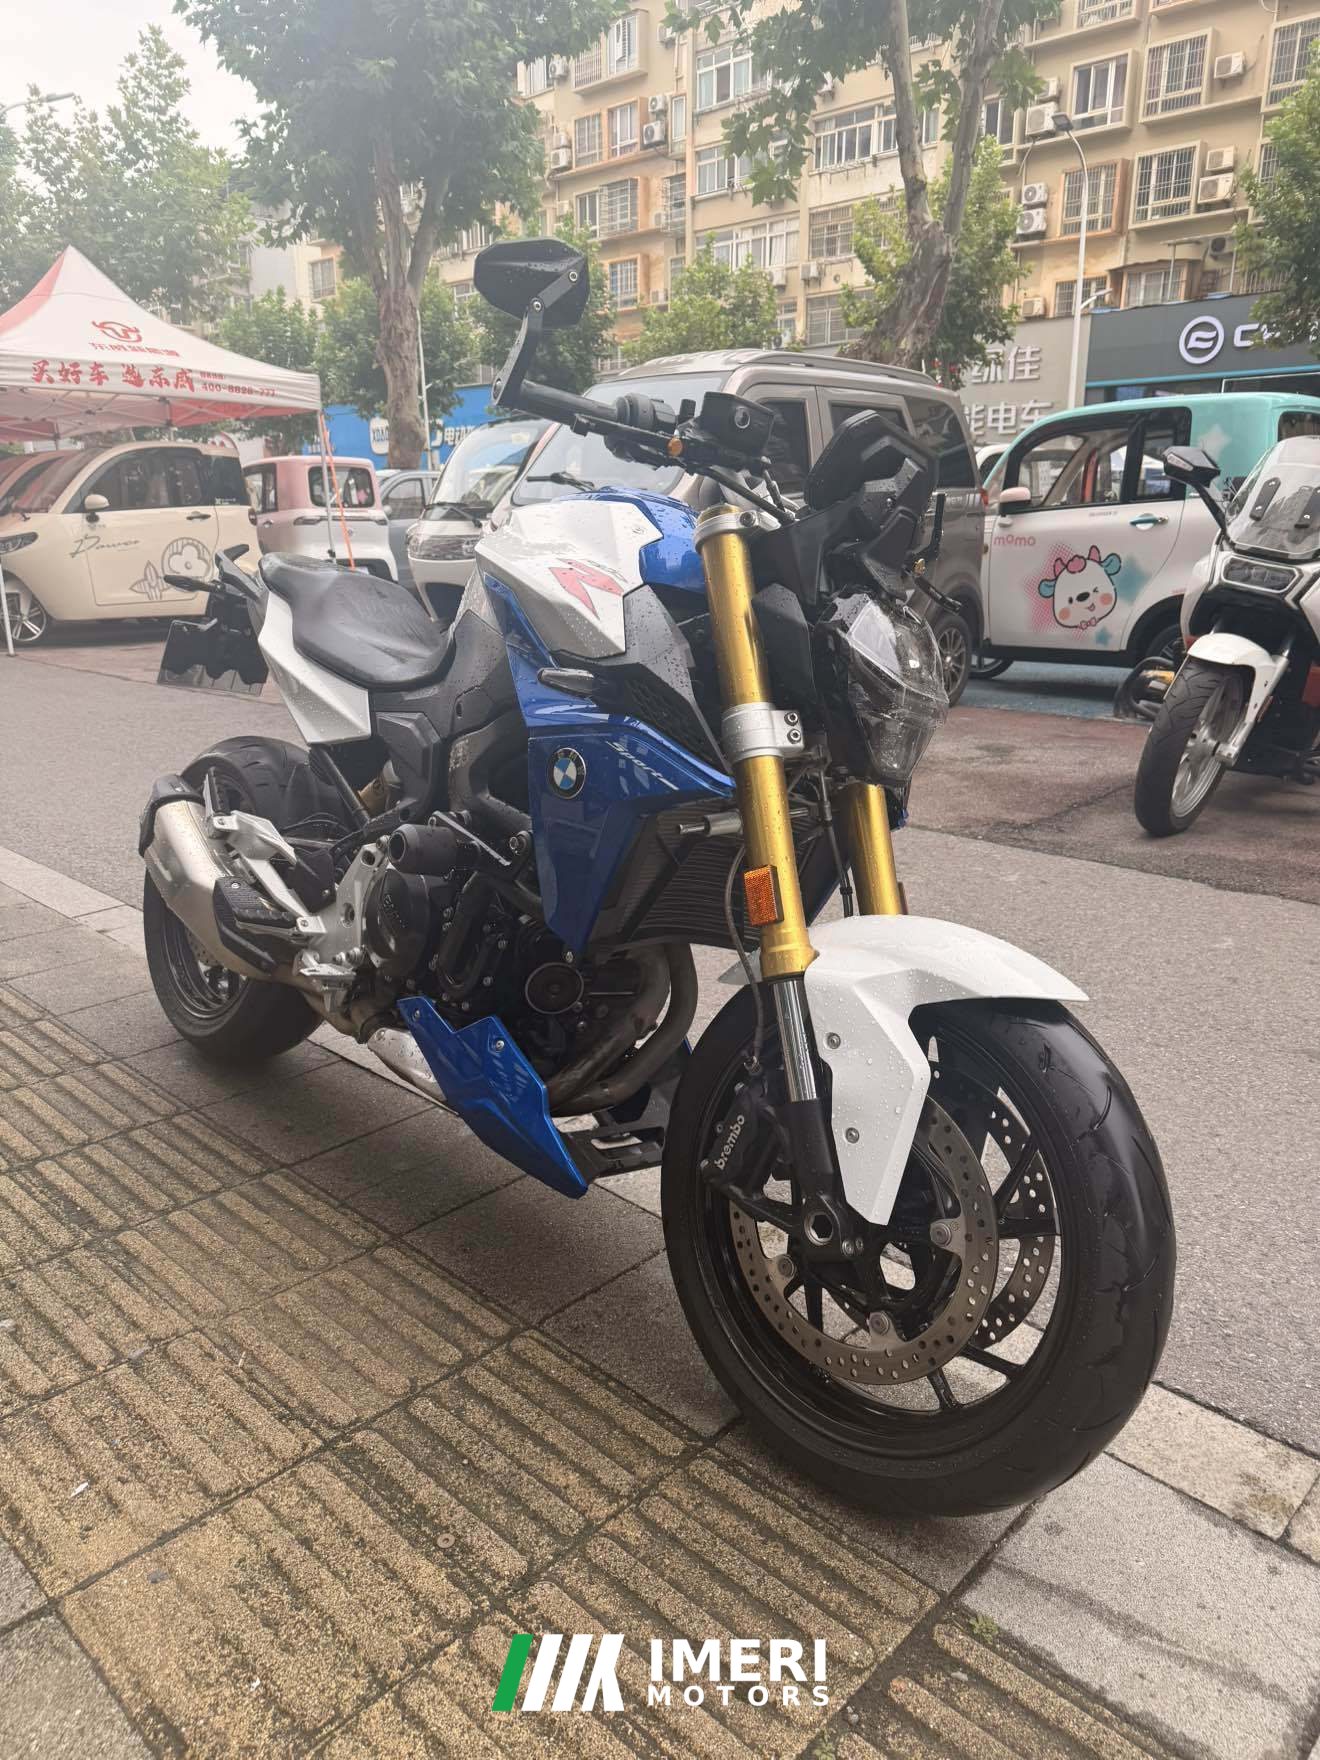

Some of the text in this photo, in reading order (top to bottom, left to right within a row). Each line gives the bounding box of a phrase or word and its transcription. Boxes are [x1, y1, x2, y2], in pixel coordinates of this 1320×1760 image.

[32, 360, 109, 386] 买好车
[993, 534, 1036, 547] momo
[714, 1114, 745, 1170] brembo
